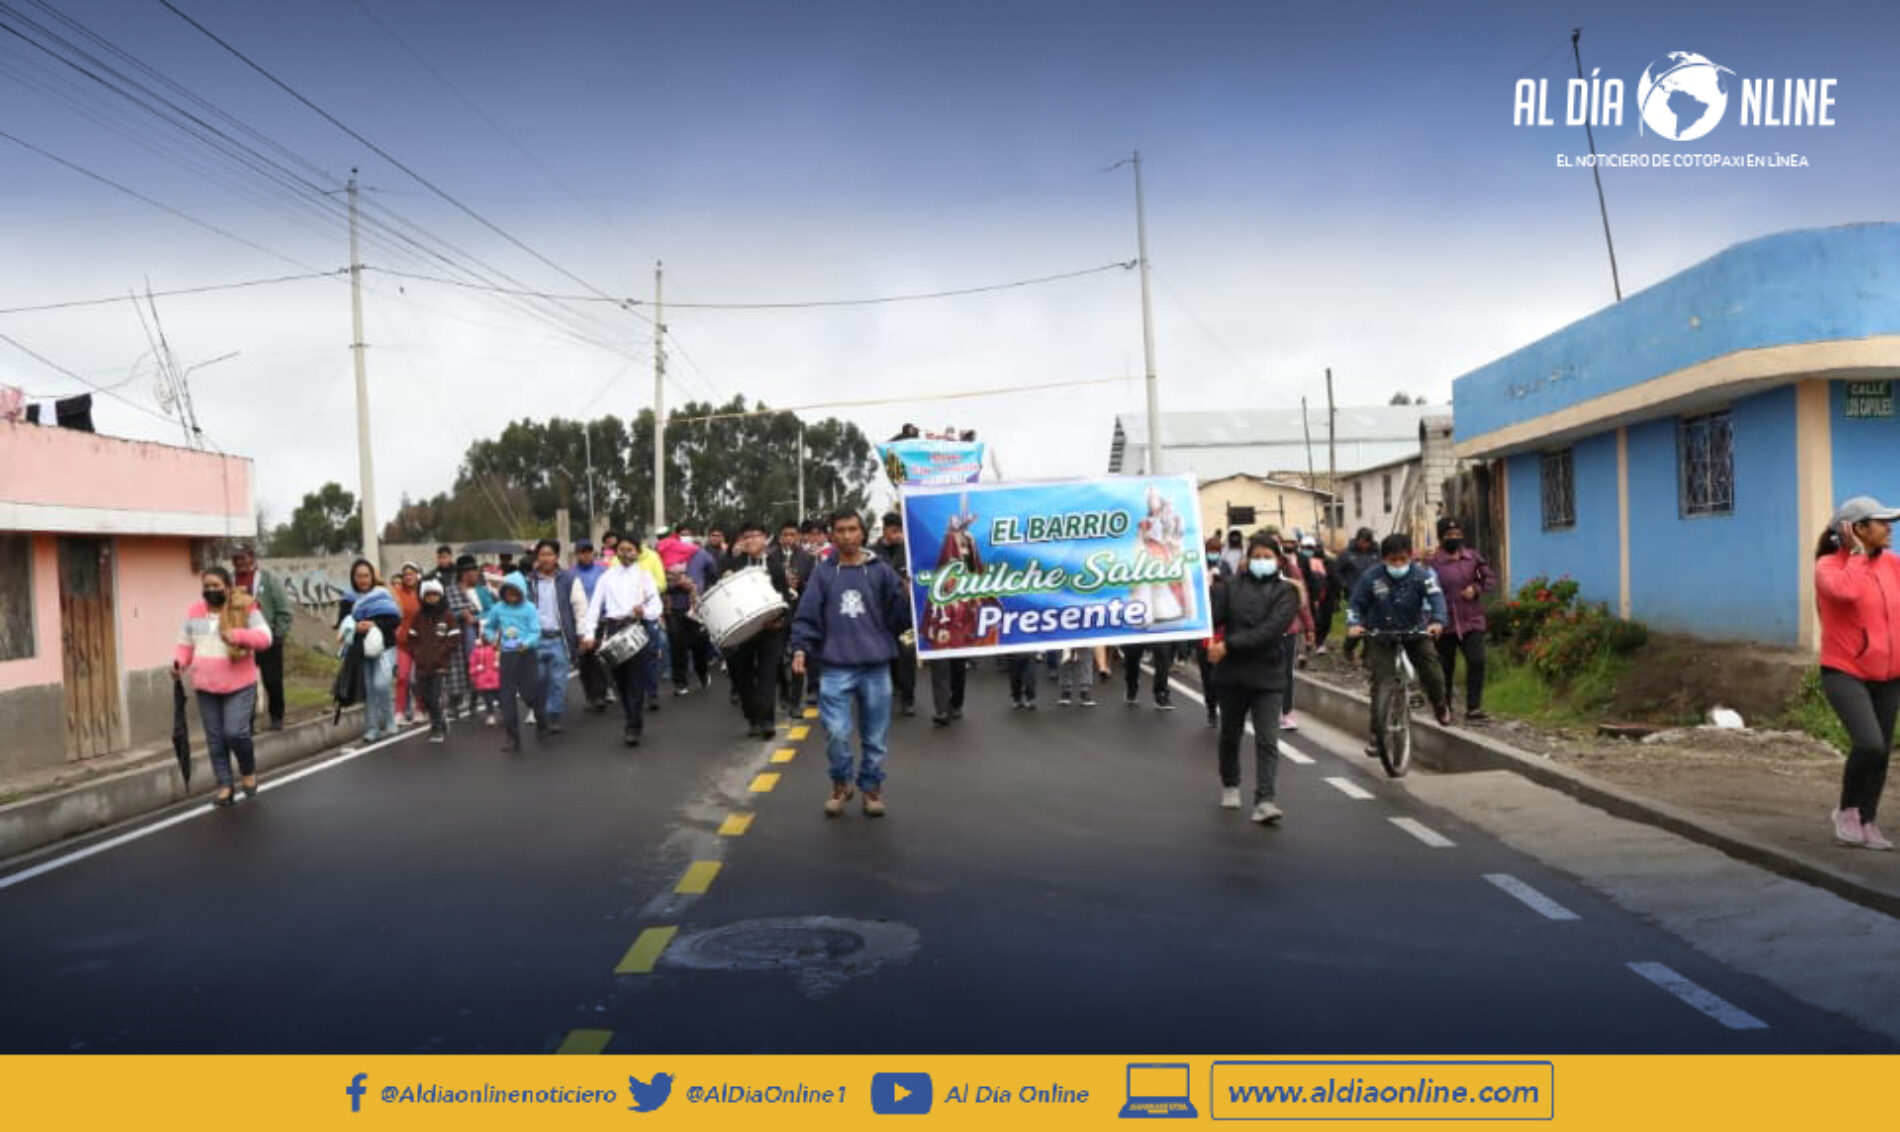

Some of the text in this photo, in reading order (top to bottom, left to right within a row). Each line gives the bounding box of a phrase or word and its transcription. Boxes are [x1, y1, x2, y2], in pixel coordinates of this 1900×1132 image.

[991, 510, 1130, 545] EL BARRIO
[976, 600, 1148, 638] Presente
